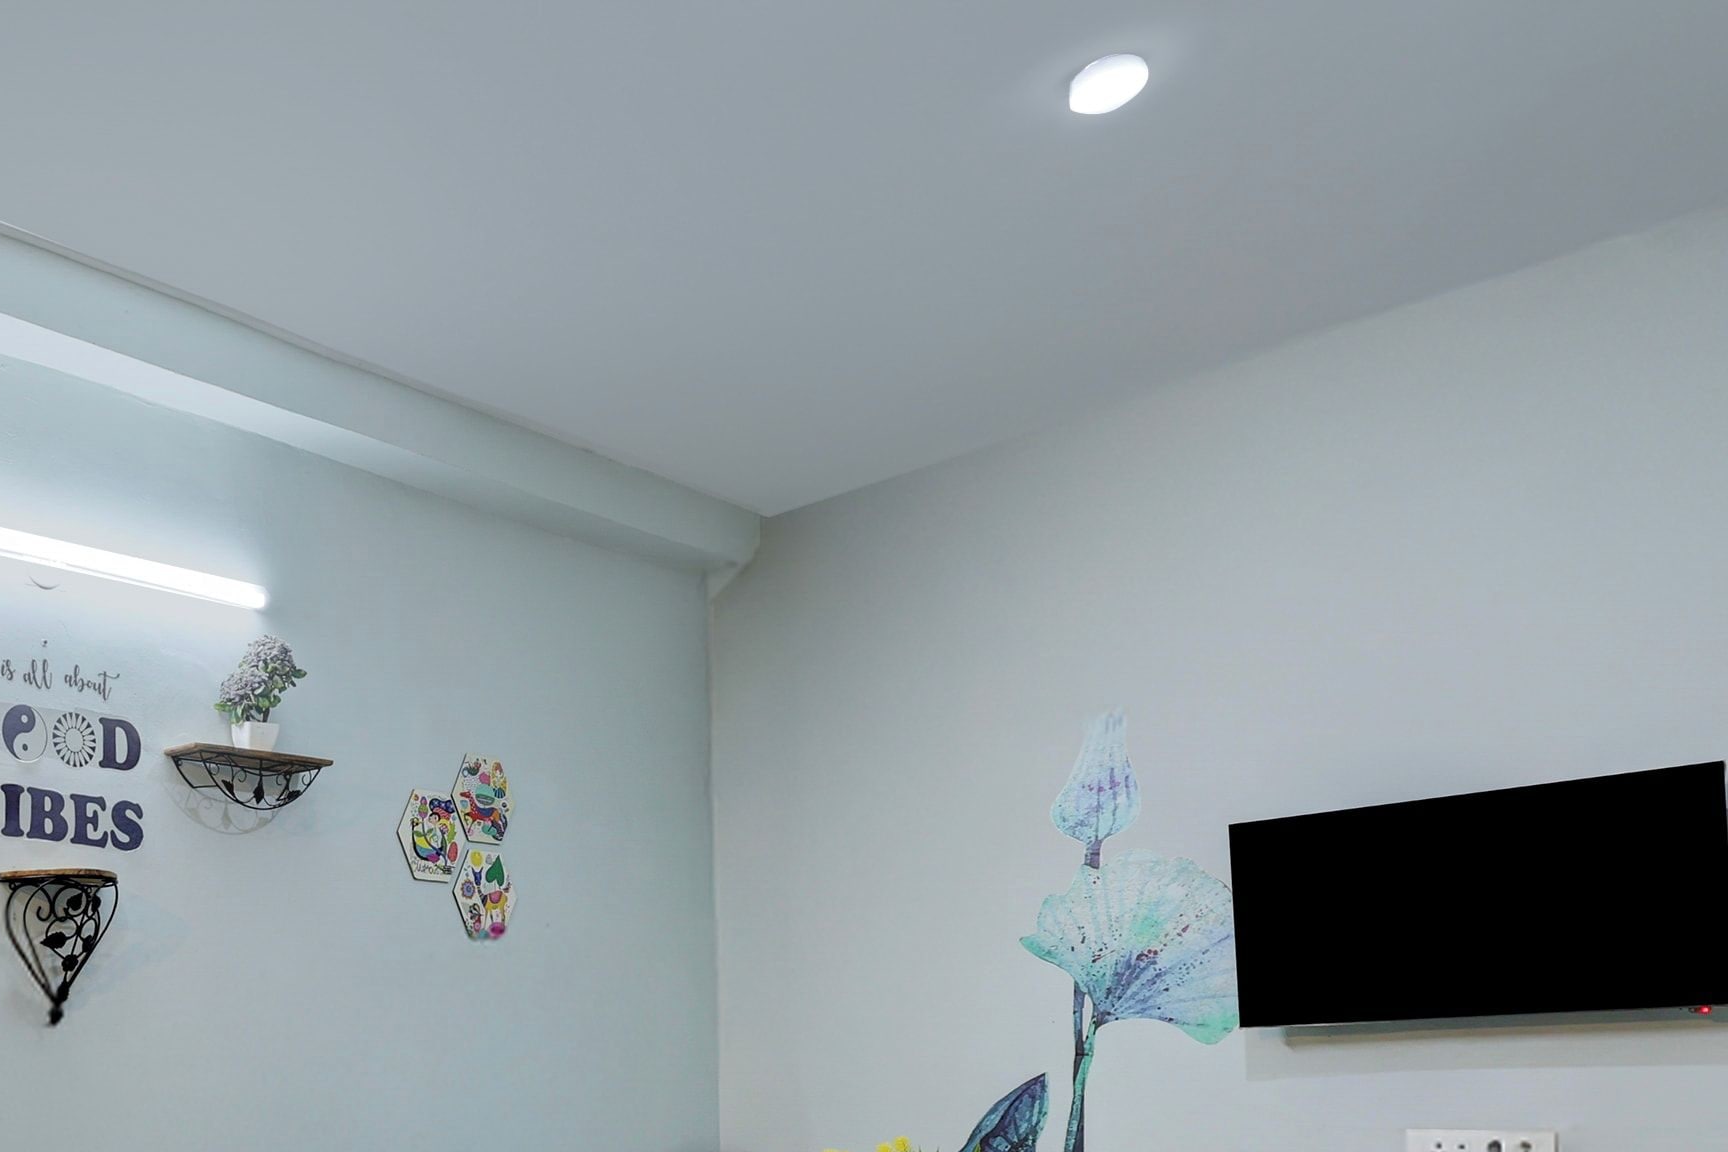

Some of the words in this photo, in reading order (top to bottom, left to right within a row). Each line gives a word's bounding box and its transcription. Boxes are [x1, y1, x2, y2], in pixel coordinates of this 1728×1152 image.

[0, 659, 16, 681] is
[22, 658, 53, 690] all
[64, 664, 120, 702] about
